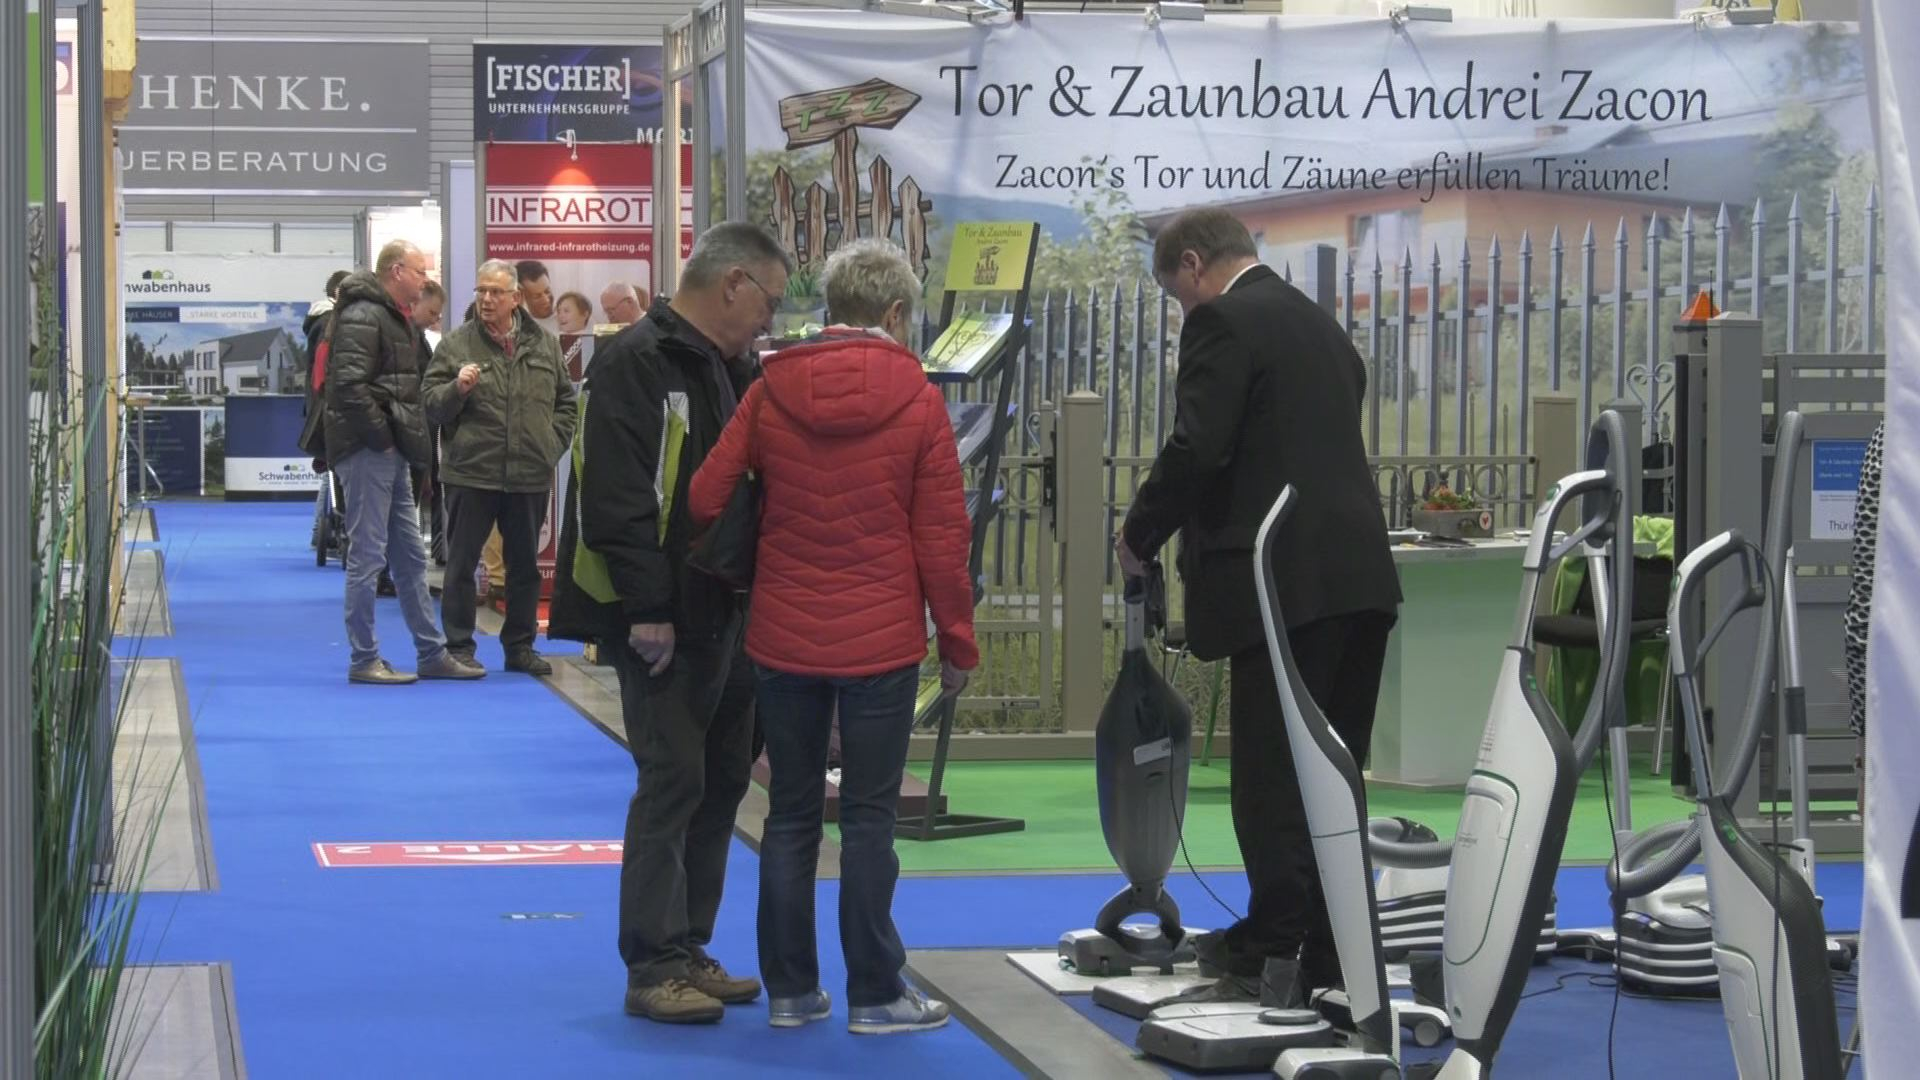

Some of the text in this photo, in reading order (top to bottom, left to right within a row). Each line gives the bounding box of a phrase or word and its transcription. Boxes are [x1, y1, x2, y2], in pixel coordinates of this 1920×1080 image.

[940, 58, 1713, 122] Tor & Zaunbau Andrei Zacon
[488, 102, 631, 115] UNTERNEHMENSGRUPPE
[1134, 155, 1194, 190] Tor
[1203, 150, 1270, 190] und
[1282, 154, 1387, 191] Zäune
[1396, 150, 1523, 203] erfüllen
[1532, 157, 1671, 192] Träume!
[489, 197, 651, 223] INFRAROT
[488, 242, 650, 254] www.infrared-infrarotheizung.de
